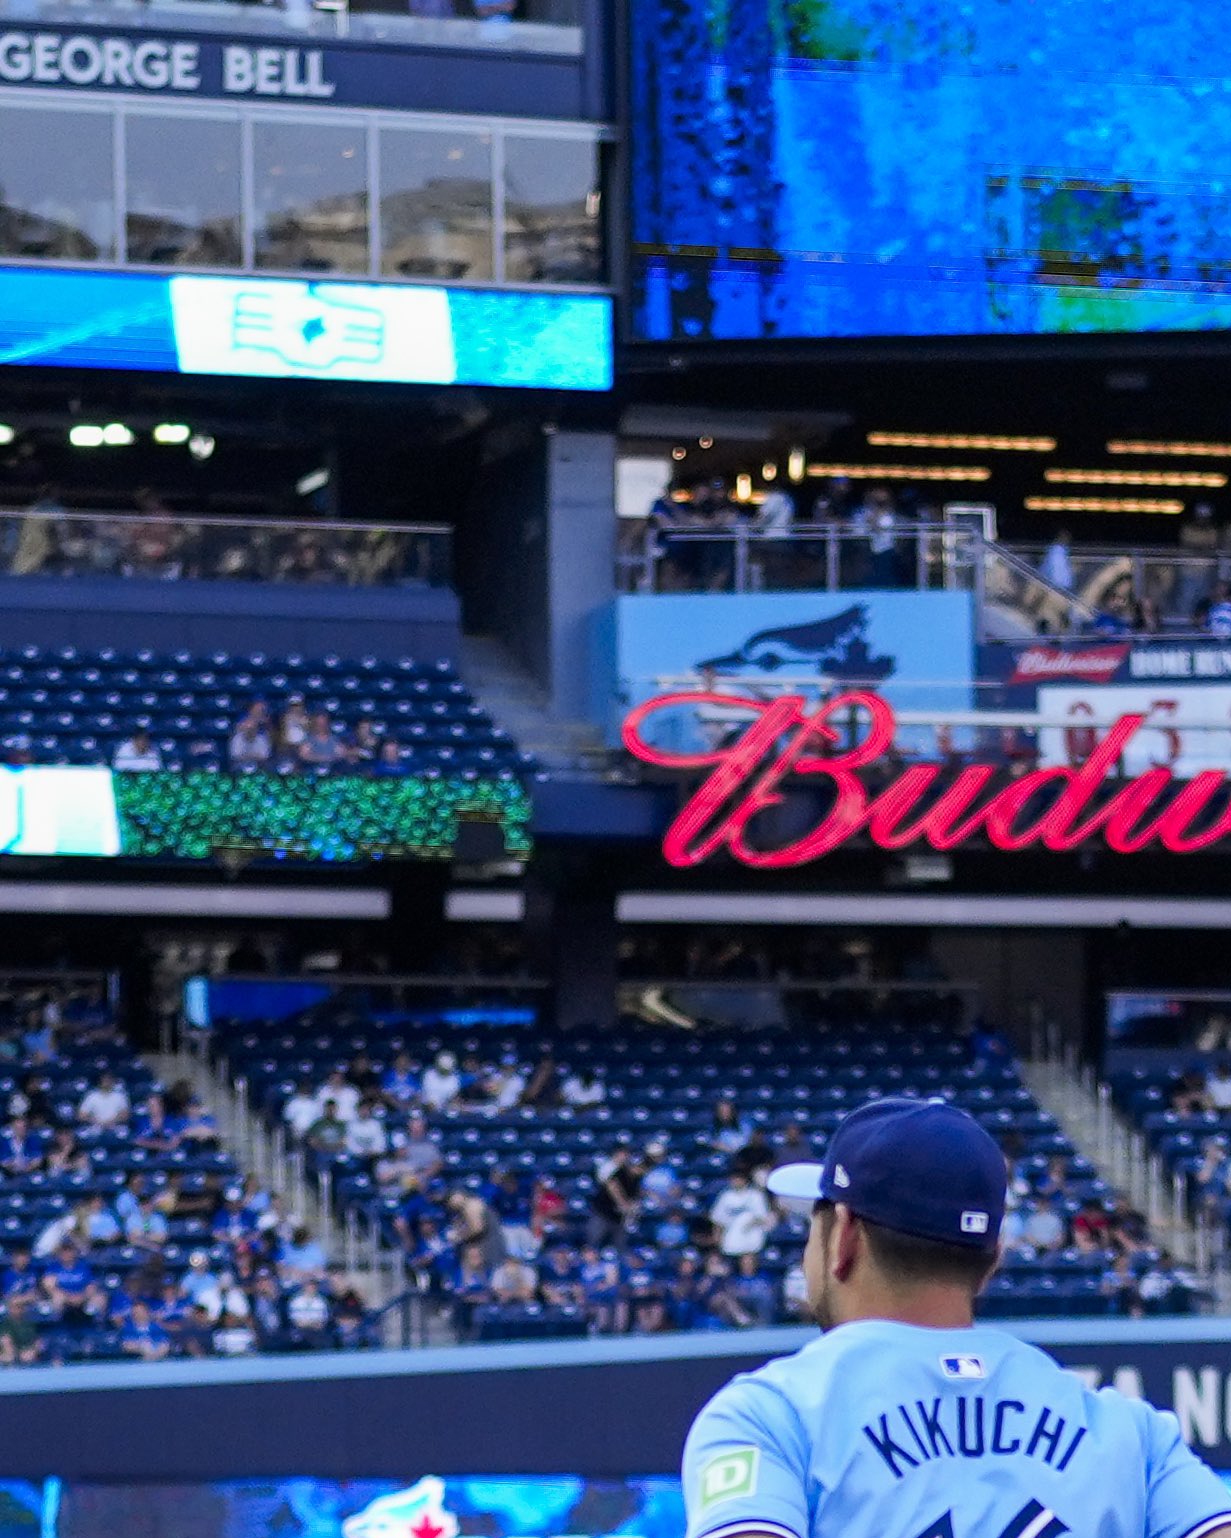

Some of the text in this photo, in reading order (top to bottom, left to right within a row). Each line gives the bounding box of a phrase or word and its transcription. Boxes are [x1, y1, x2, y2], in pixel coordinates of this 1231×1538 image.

[0, 33, 336, 97] GEORGE BELL
[863, 1395, 1088, 1478] KIKUCHI
